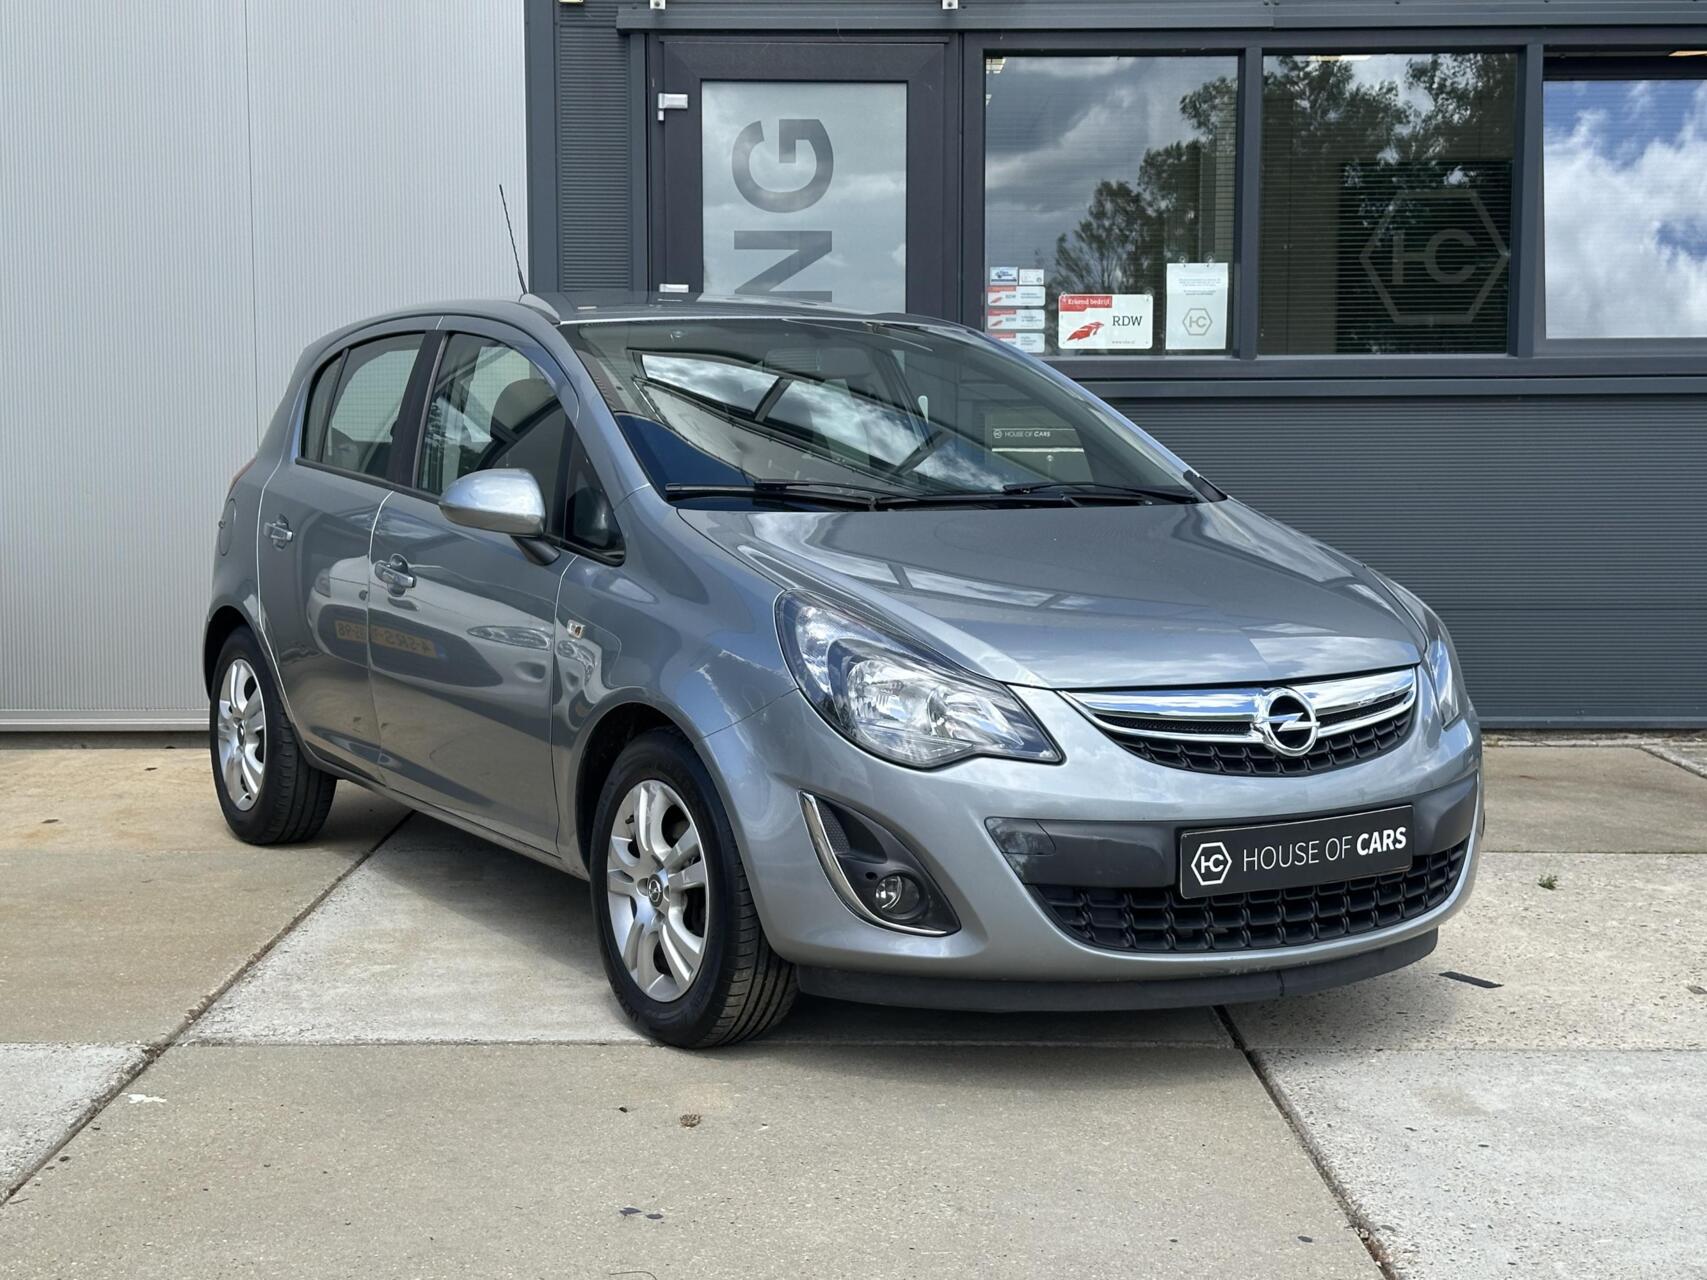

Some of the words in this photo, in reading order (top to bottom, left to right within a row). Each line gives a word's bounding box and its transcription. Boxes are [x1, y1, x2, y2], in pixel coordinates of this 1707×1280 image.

[1112, 315, 1143, 327] RDW
[1243, 841, 1320, 872] HOUSE
[1325, 836, 1352, 861] OF
[1356, 826, 1407, 856] CARS
